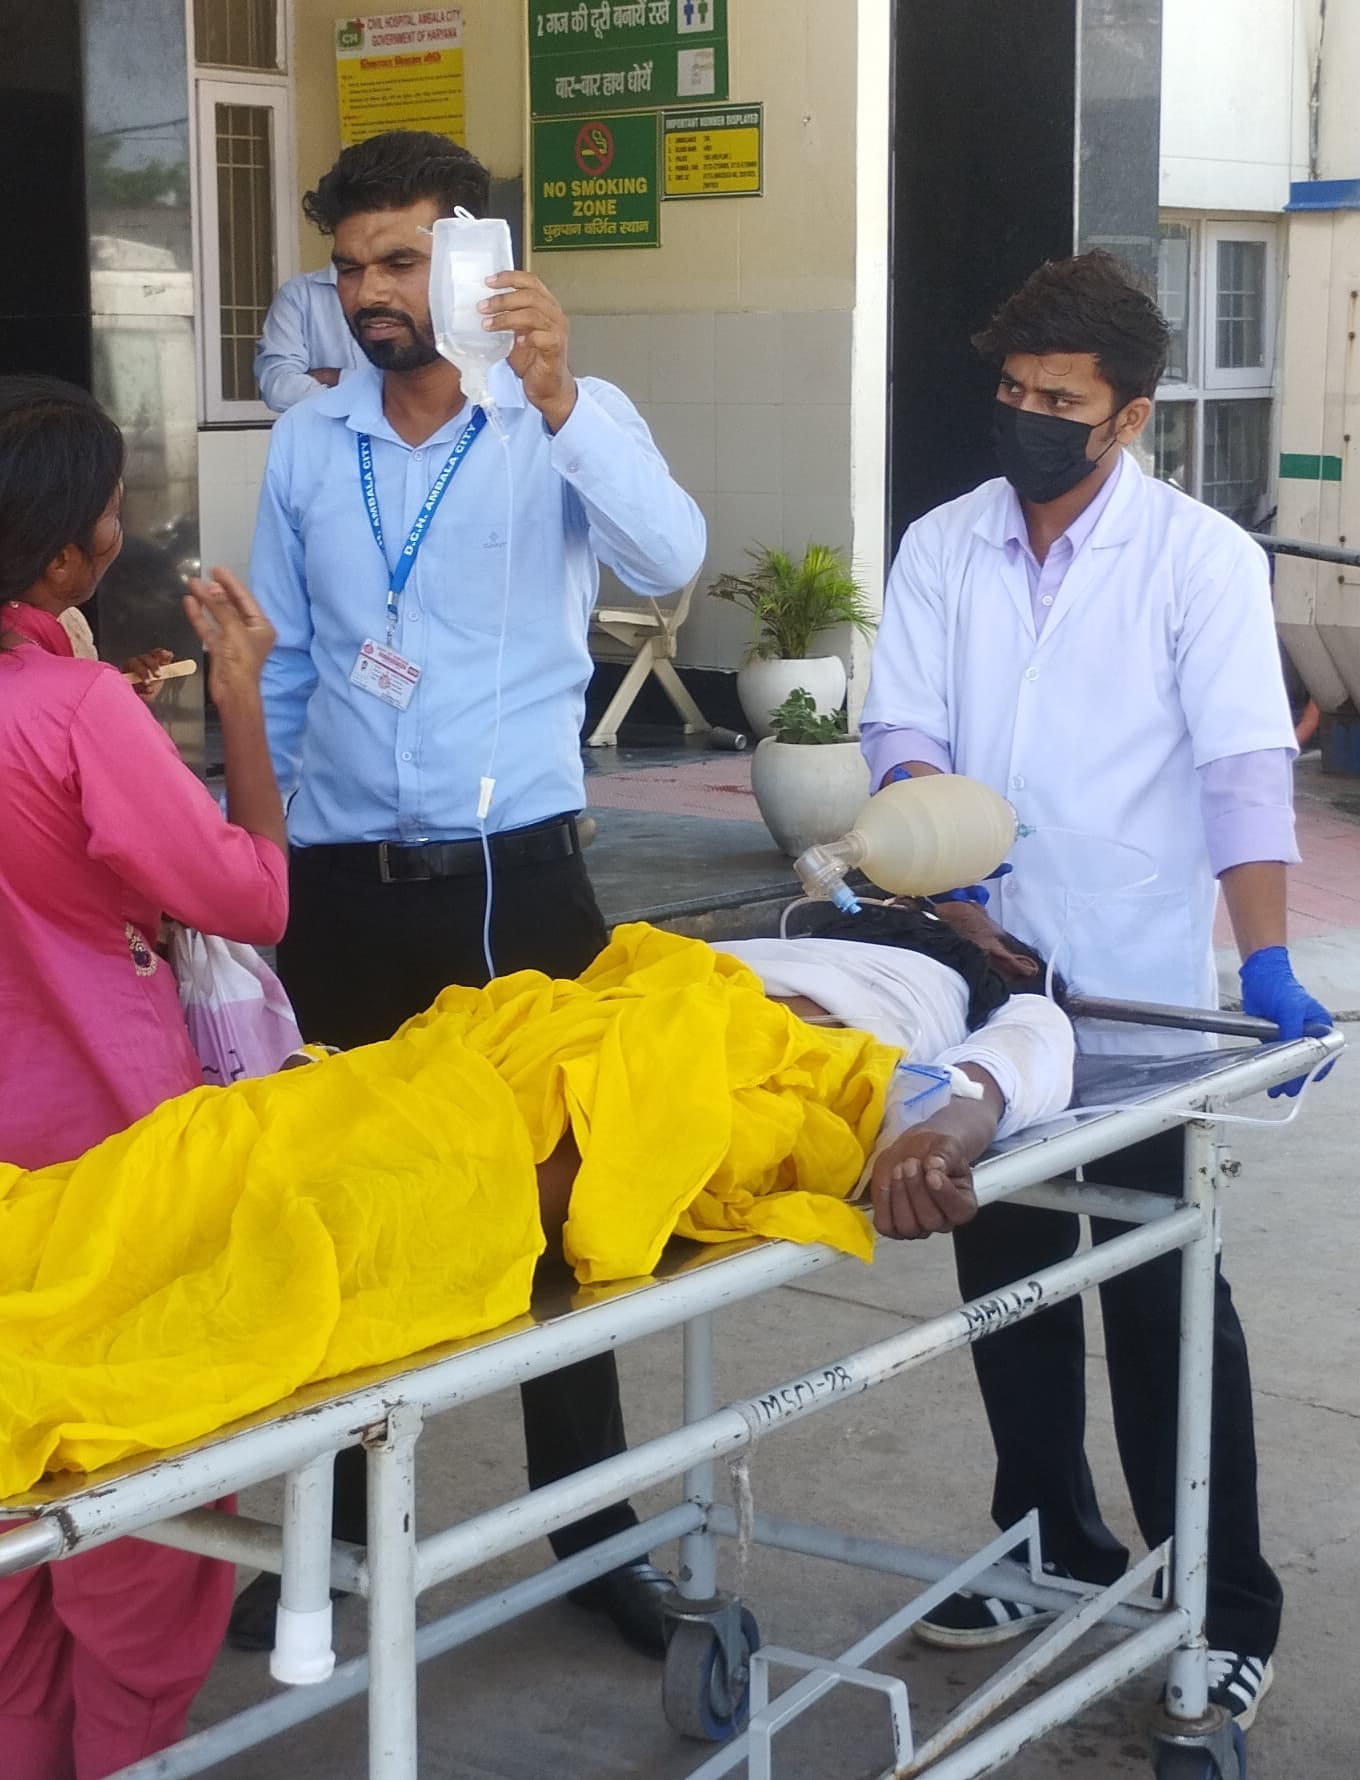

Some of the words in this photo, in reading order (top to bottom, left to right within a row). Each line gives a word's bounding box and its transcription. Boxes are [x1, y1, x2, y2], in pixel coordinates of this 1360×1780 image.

[546, 12, 569, 35] गज
[571, 3, 589, 33] की
[542, 181, 567, 198] NO
[571, 177, 648, 197] SMOKING
[572, 199, 617, 217] ZONE
[424, 457, 458, 511] AMBALA
[455, 423, 477, 454] CITY
[363, 471, 380, 527] AMBALA
